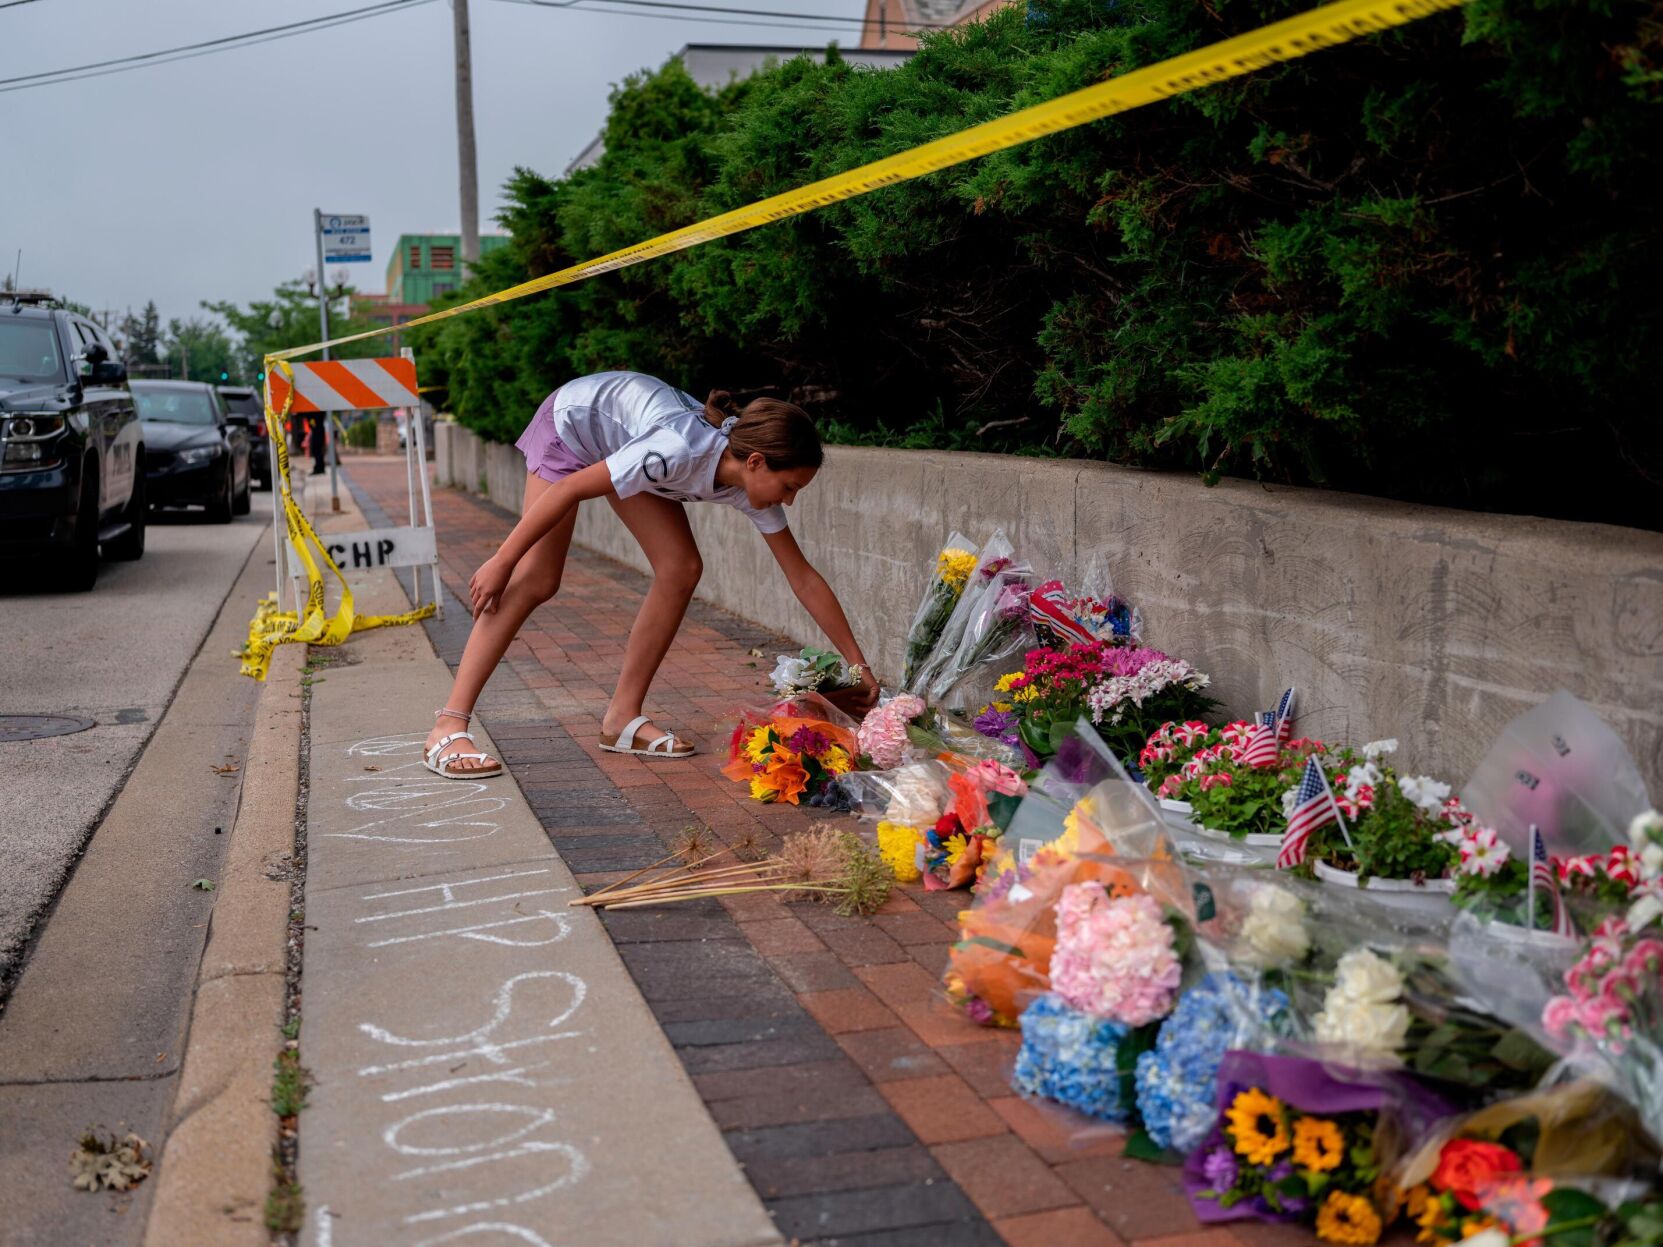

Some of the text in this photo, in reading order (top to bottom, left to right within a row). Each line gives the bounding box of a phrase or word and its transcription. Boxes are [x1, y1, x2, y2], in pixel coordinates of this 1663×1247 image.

[327, 539, 395, 569] CHP
[316, 869, 590, 1247] HP Stron
